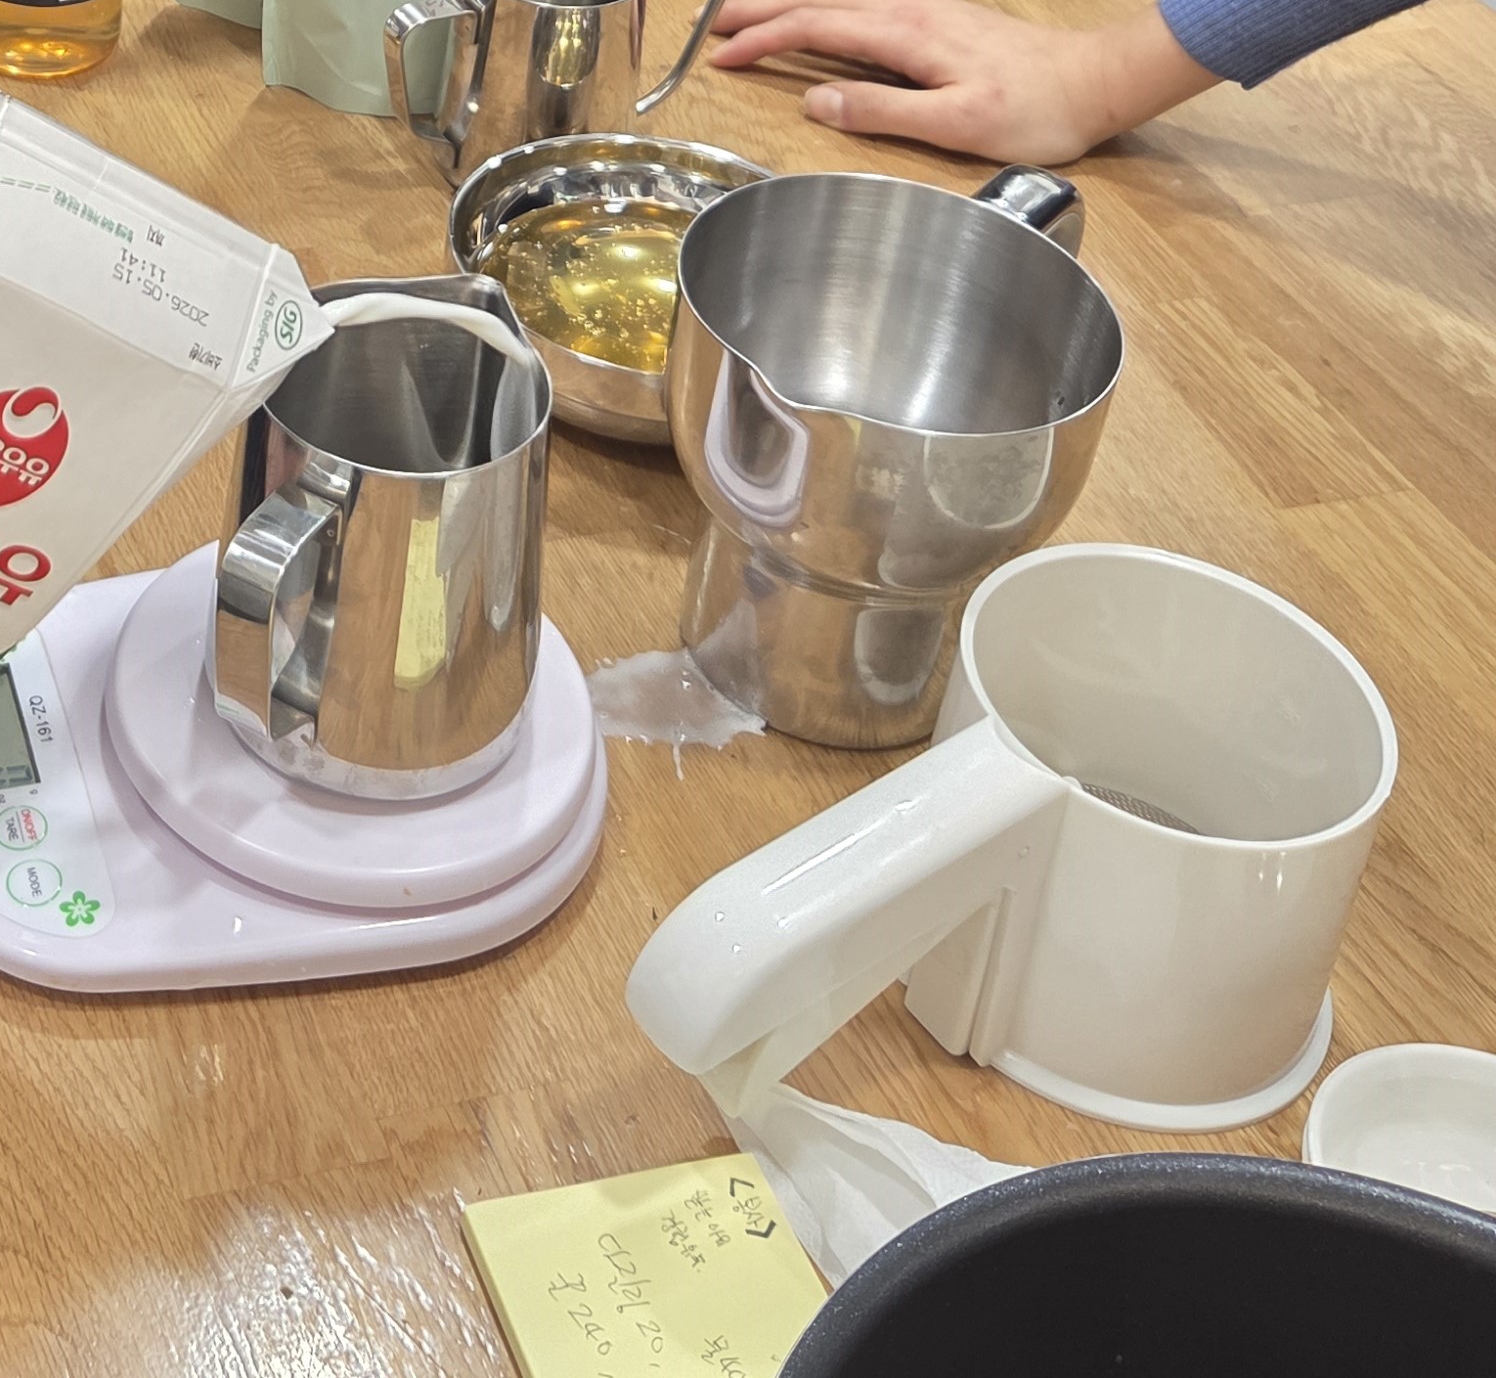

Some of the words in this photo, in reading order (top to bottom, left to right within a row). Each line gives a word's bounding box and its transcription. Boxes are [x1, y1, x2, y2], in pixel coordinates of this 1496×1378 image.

[117, 247, 168, 283] 11:41
[112, 262, 210, 328] 2026.05.15
[246, 308, 273, 373] Packaging
[263, 289, 278, 306] by
[279, 307, 300, 343] SIG
[188, 341, 222, 371] 소비기한
[28, 695, 54, 744] QZ-161
[5, 817, 20, 842] TARE
[27, 866, 43, 898] MODE
